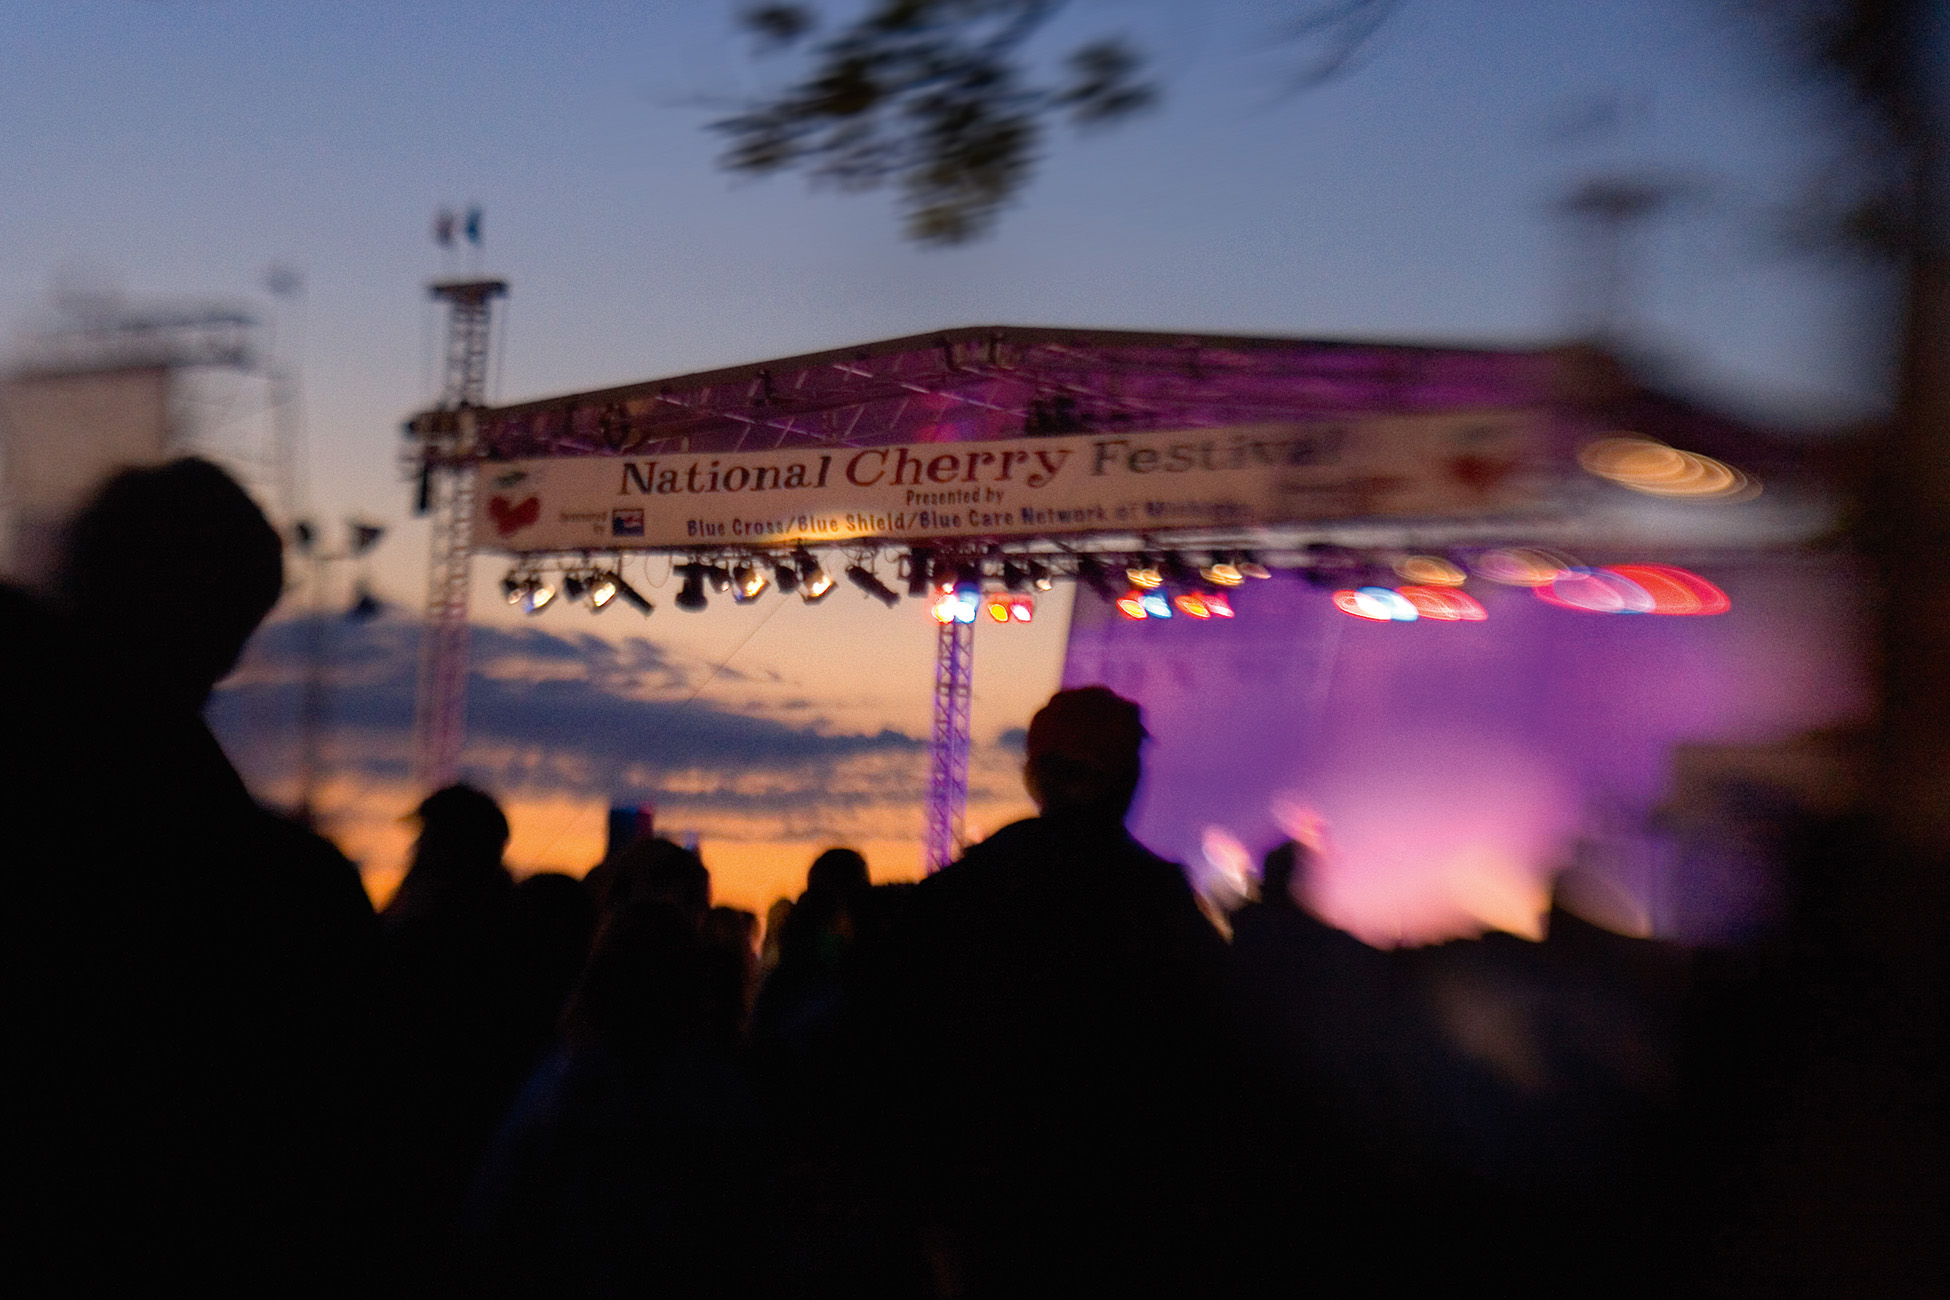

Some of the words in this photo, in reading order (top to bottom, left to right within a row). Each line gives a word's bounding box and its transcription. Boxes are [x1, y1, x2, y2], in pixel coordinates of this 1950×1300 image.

[617, 455, 833, 495] National
[845, 448, 1073, 489] Cherry
[906, 487, 980, 506] Presented
[986, 487, 1004, 506] by
[687, 518, 725, 537] Blue
[732, 514, 839, 536] Cross/Blue
[846, 510, 962, 533] Shield/Blue
[968, 508, 1014, 527] Care
[1020, 505, 1105, 525] Network
